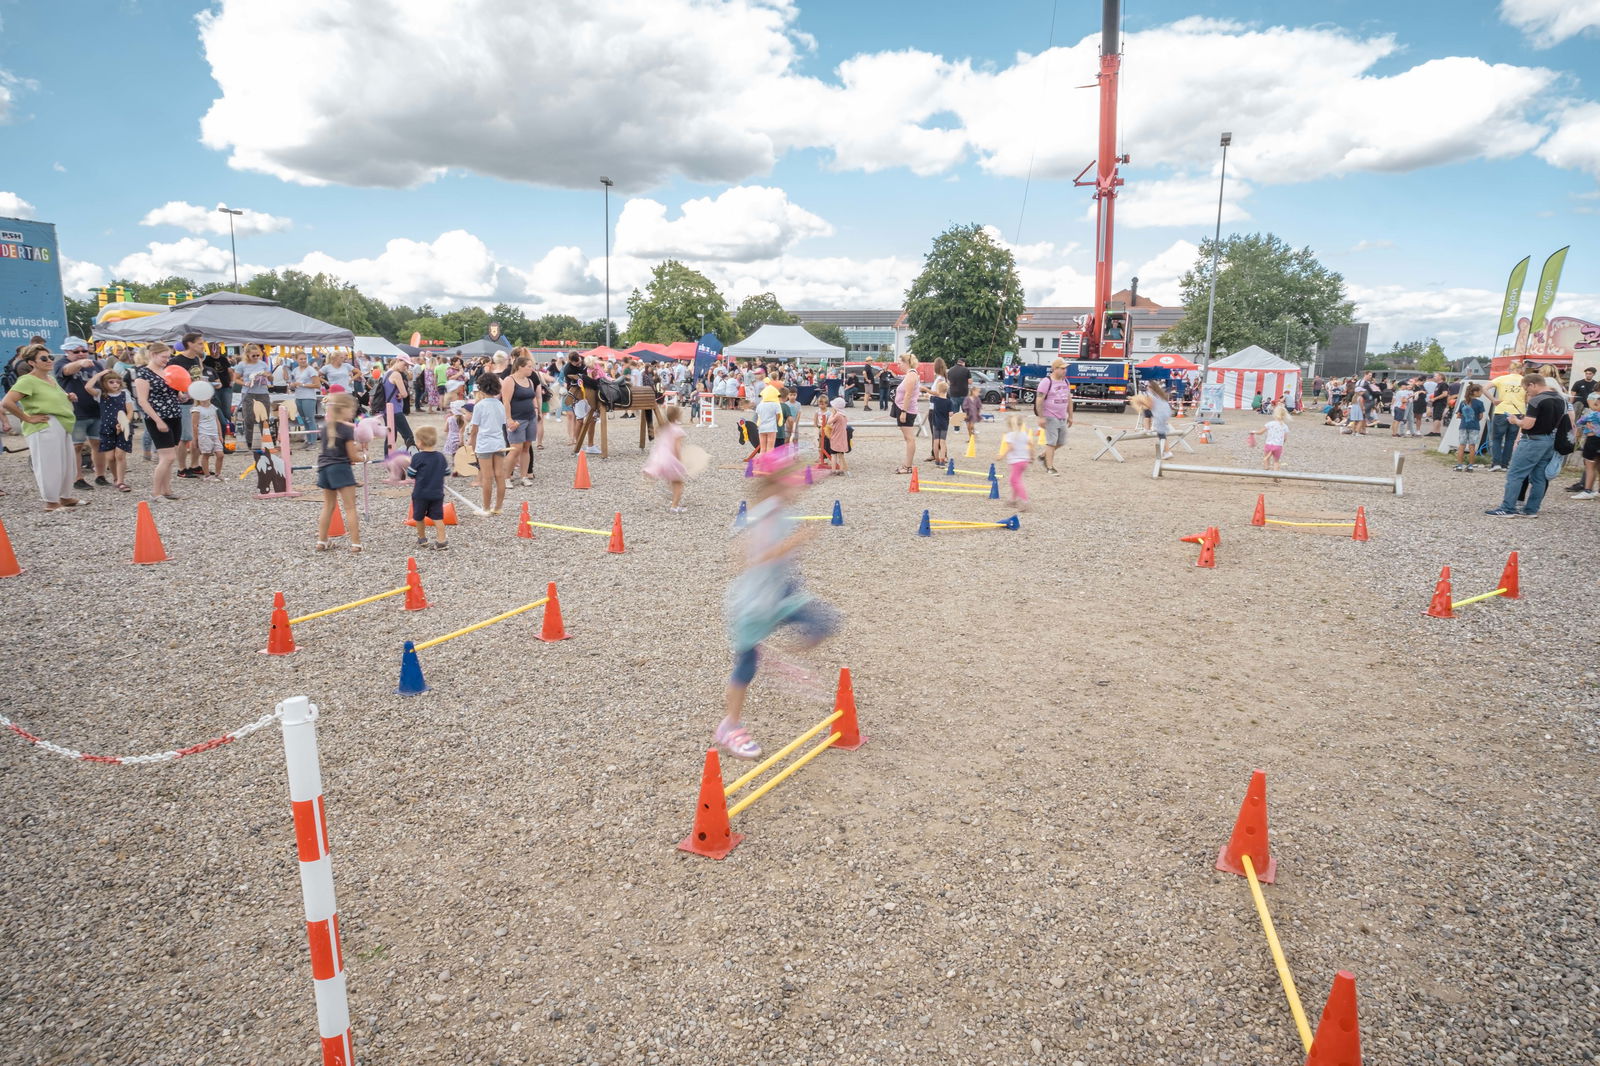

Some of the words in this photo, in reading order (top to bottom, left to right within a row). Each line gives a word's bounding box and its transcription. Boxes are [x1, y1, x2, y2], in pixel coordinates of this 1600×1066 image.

[2, 231, 22, 240] RSH
[1, 244, 49, 262] DERTAG
[1542, 279, 1553, 305] vegan
[1506, 287, 1518, 318] vegan
[9, 316, 59, 328] wünschen
[1, 327, 20, 338] viel
[22, 328, 51, 339] Spaß!
